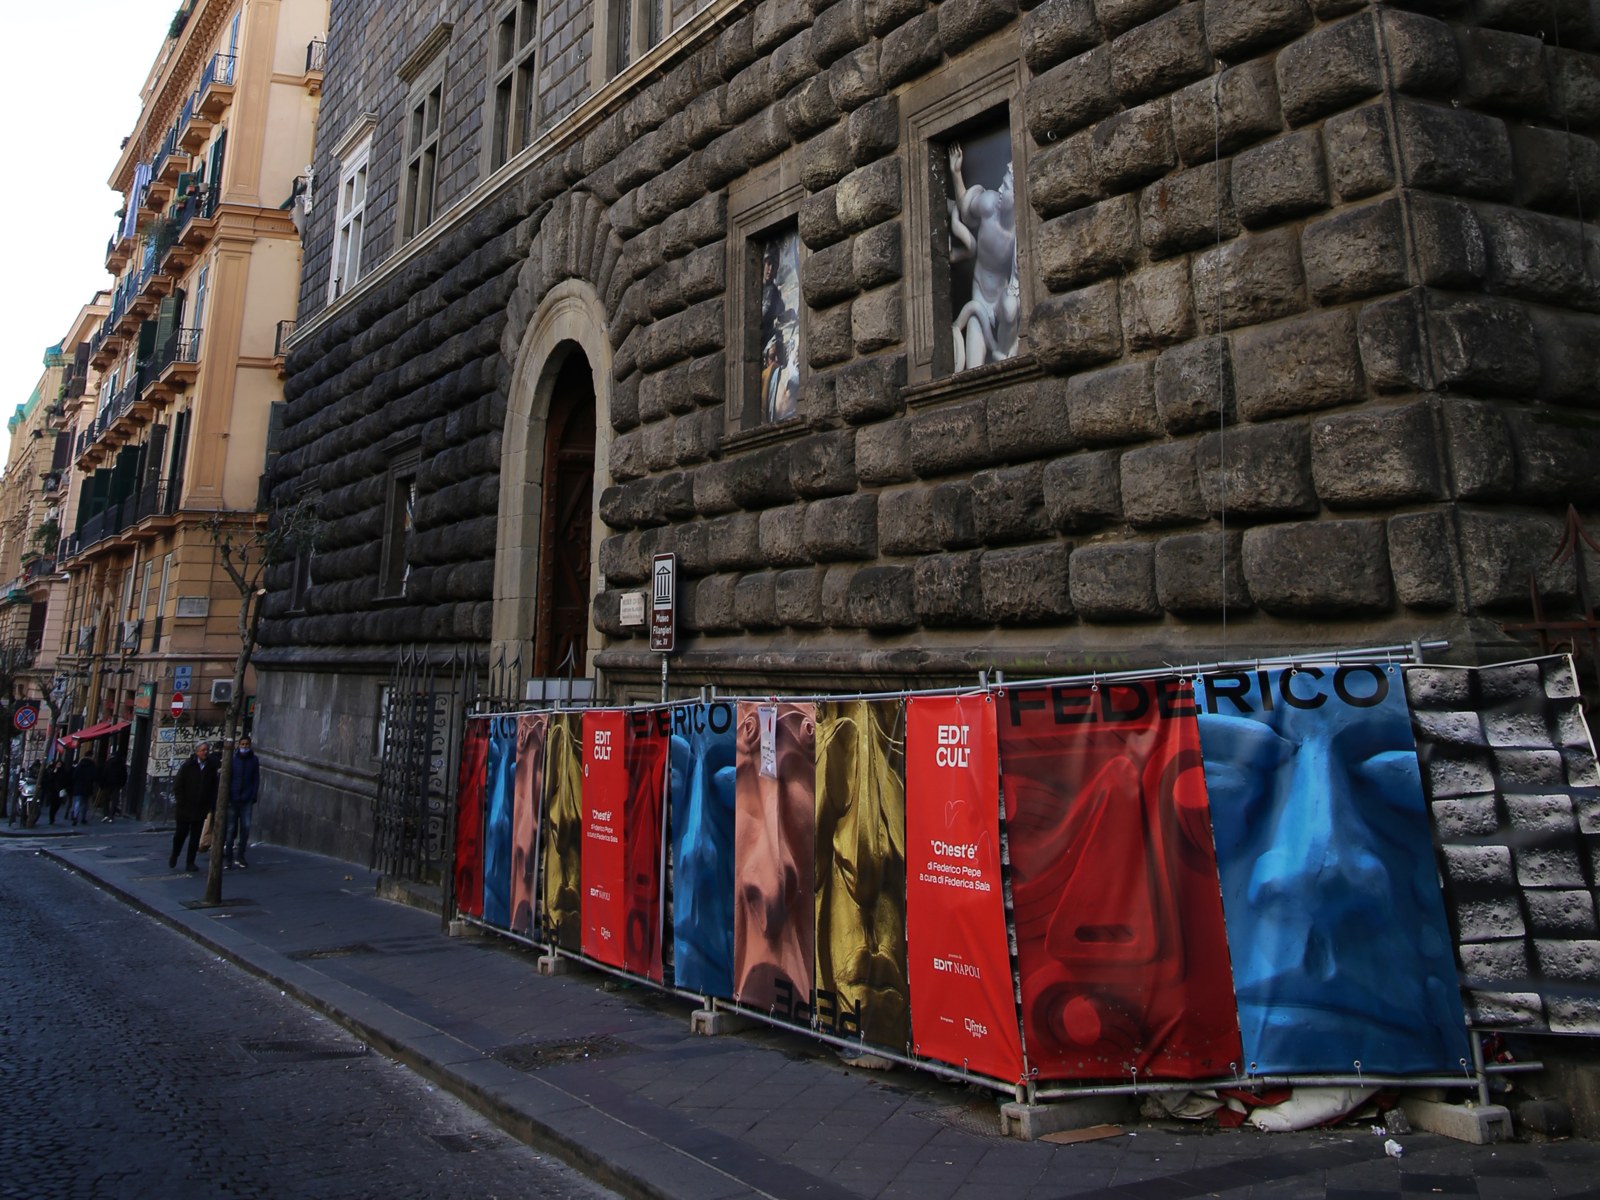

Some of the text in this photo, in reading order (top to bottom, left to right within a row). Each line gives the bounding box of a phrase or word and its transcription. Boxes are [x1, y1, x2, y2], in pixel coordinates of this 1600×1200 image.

[656, 614, 669, 622] Museo
[653, 626, 671, 636] Filangieri
[1008, 666, 1390, 726] FEDERICO
[595, 731, 611, 745] EDIT
[937, 725, 970, 745] EDIT
[594, 746, 611, 760] CULT
[936, 746, 971, 768] CULT
[933, 862, 961, 874] Federico
[962, 866, 982, 878] Pepe
[924, 874, 937, 883] cura
[938, 875, 944, 884] di
[944, 877, 974, 889] Federica
[975, 881, 990, 891] Sala
[933, 958, 981, 979] EDIT NAPOLI
